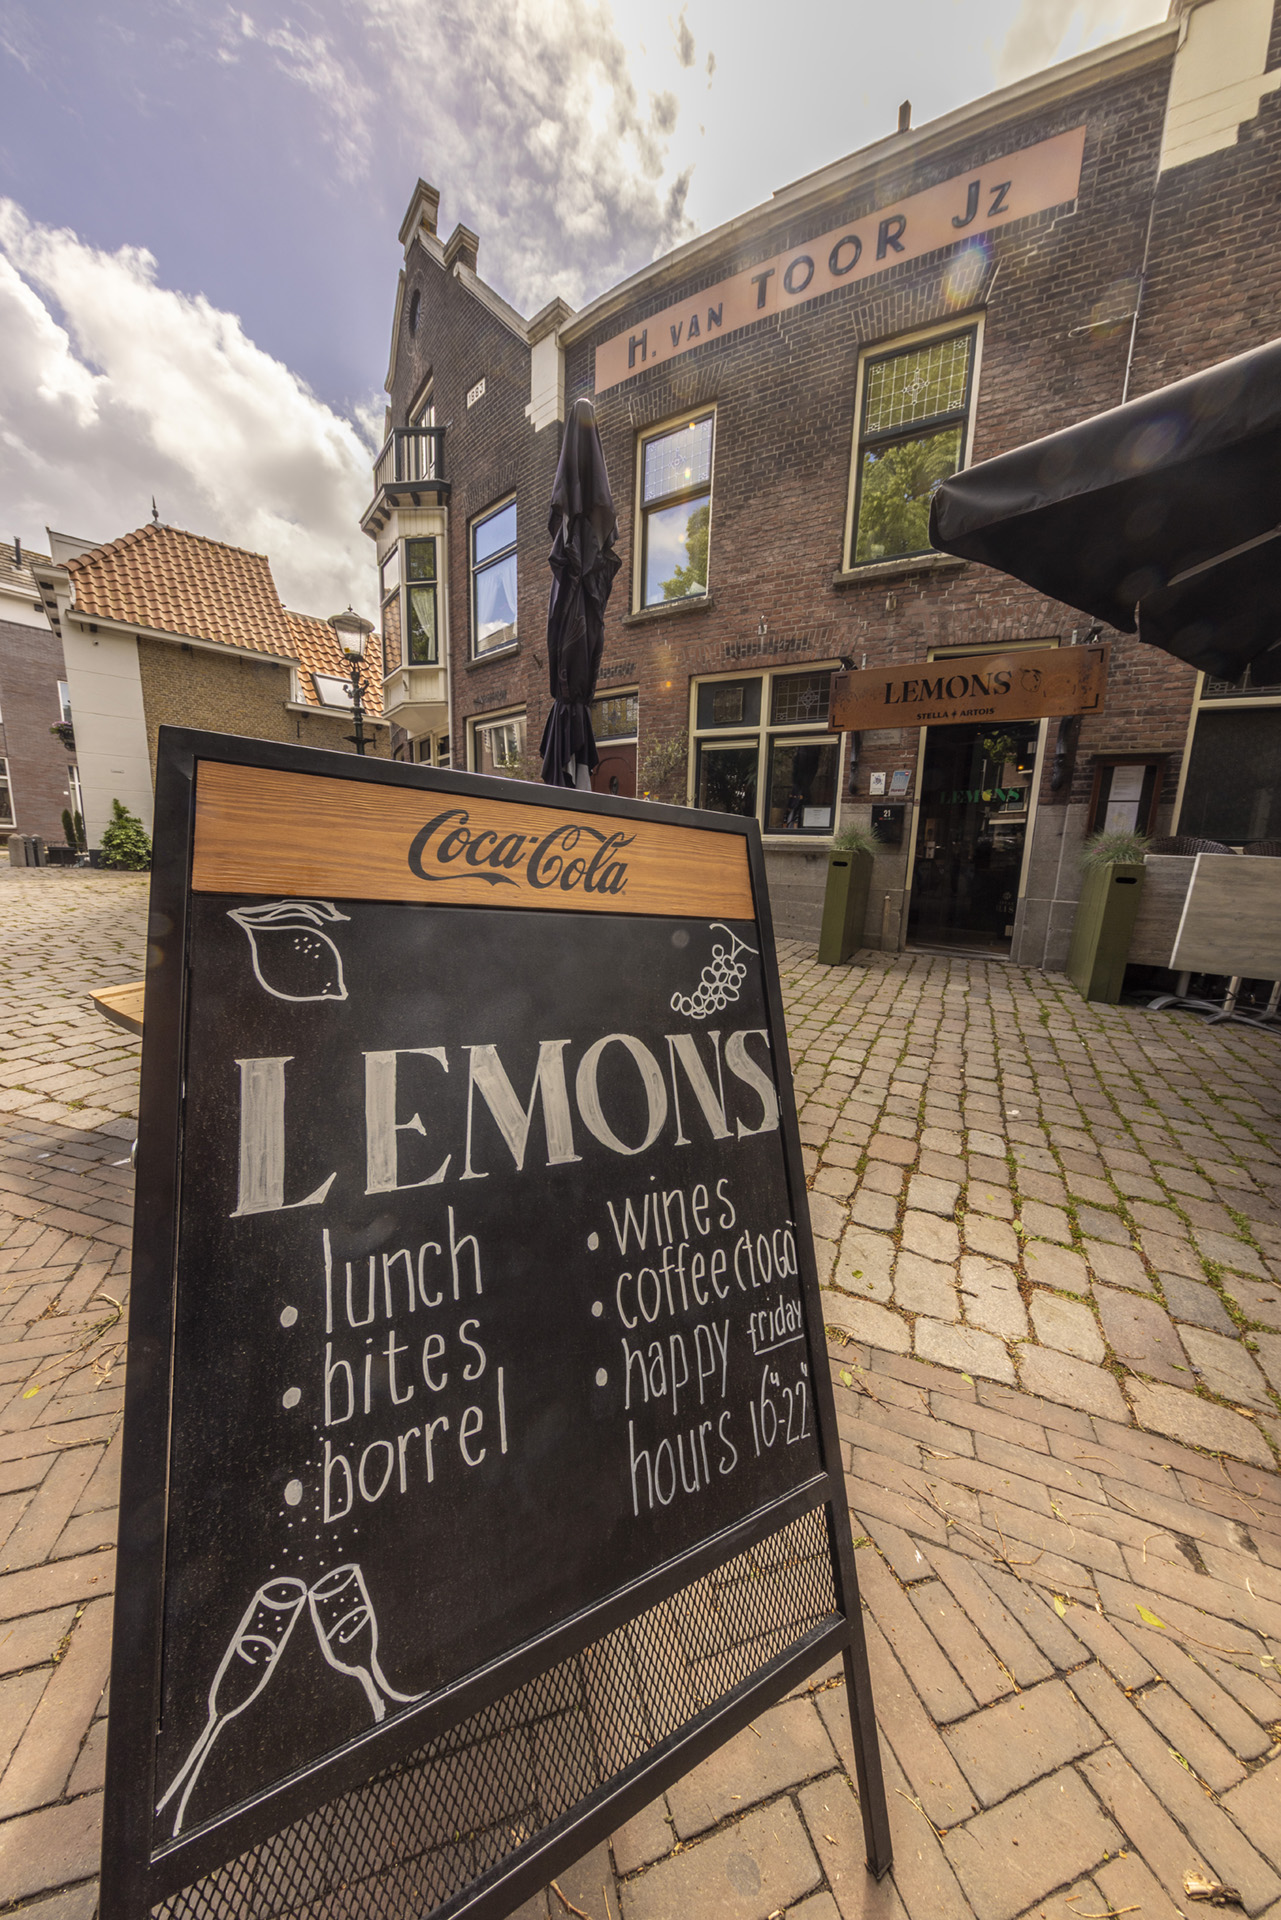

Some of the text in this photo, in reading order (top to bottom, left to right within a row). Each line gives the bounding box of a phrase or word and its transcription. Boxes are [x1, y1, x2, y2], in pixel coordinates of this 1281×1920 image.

[628, 328, 657, 369] H.
[669, 301, 724, 349] VAN
[750, 213, 907, 310] TOOR
[883, 670, 1013, 705] LEMONS
[916, 707, 995, 721] STELLA ARTOIS
[407, 808, 638, 895] Coca-Cola
[883, 809, 891, 817] 21
[229, 1028, 780, 1218] LEMONS
[322, 1204, 483, 1334] lunch
[606, 1175, 737, 1256] wines
[616, 1242, 730, 1329] coffee
[323, 1318, 487, 1427] bites
[621, 1294, 802, 1416] happy friday
[323, 1366, 508, 1524] borrel
[628, 1410, 738, 1517] hours
